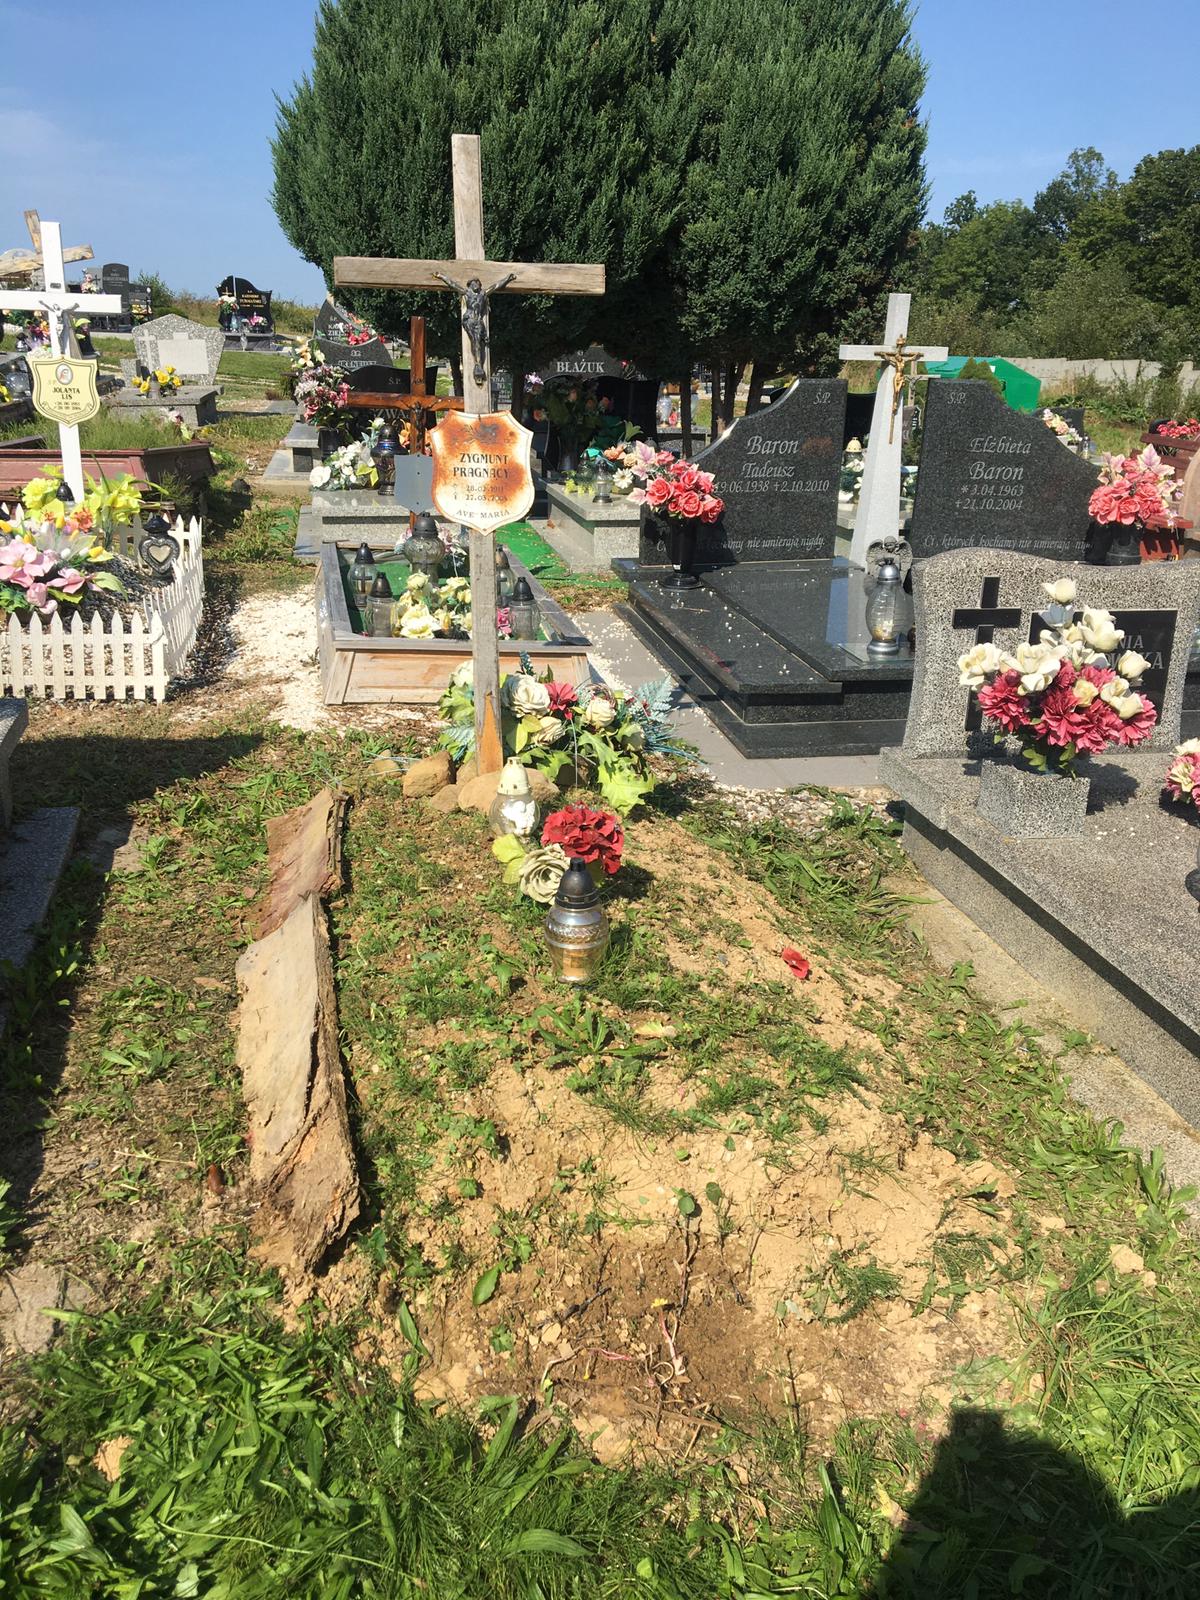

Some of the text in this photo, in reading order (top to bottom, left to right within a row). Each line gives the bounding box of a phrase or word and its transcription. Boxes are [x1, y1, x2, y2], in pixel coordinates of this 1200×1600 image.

[746, 435, 799, 456] Baron
[970, 435, 1032, 455] Elżbieta
[459, 452, 508, 465] ZYGMUNT
[741, 460, 795, 478] Tadeusz
[969, 461, 1025, 482] Baron
[456, 509, 510, 519] AVE MARIA
